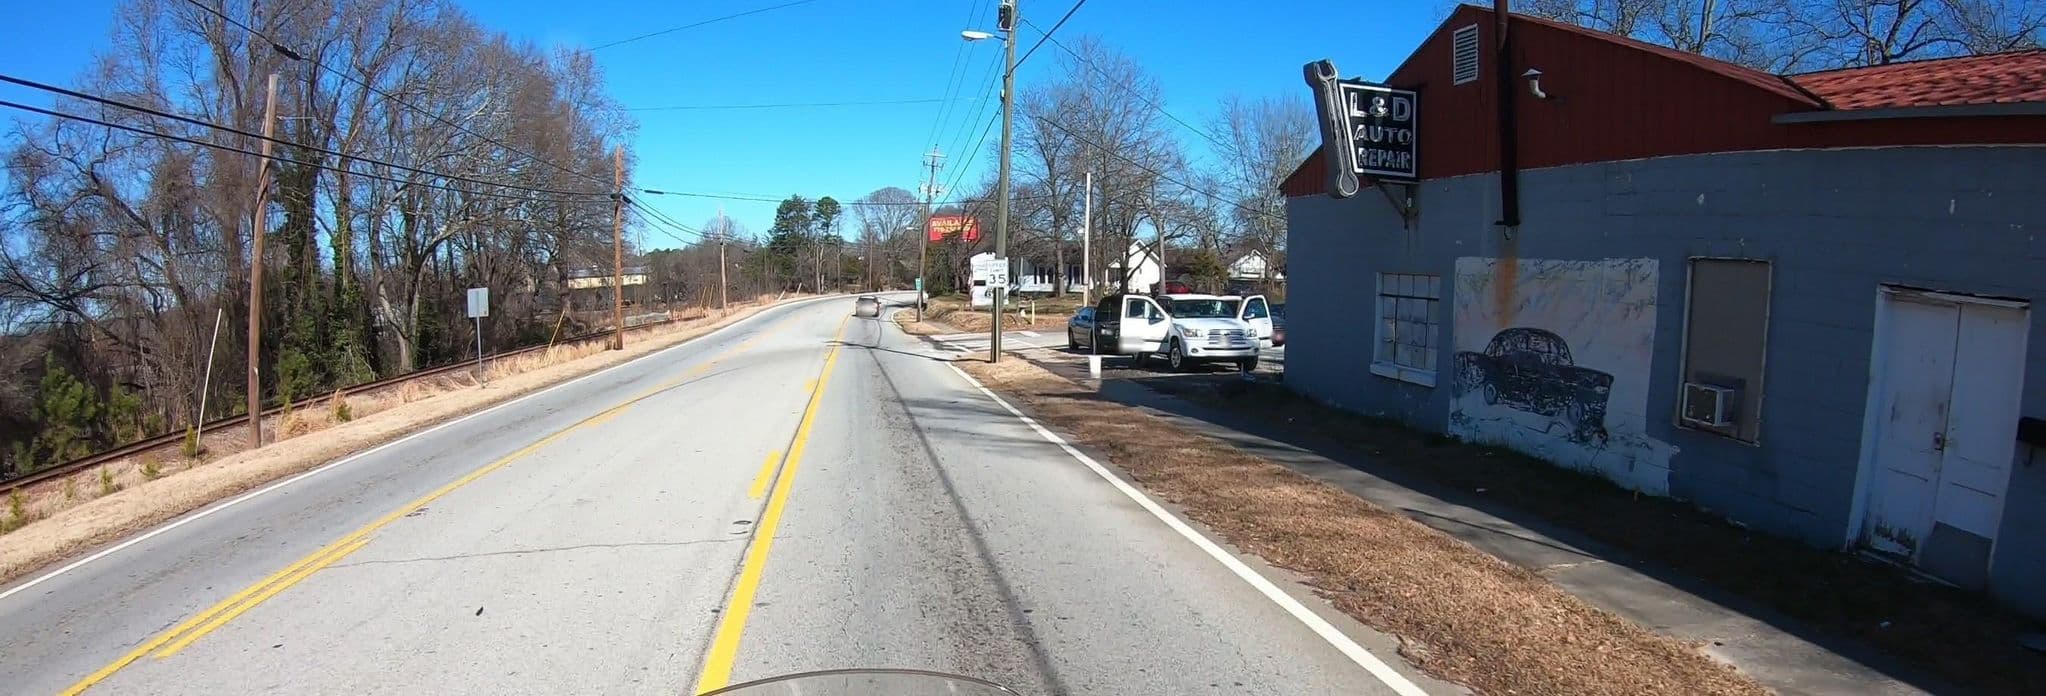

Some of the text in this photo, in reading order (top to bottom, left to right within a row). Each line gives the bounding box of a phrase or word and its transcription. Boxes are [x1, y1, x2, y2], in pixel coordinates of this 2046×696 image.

[1354, 124, 1412, 145] AUTO
[1358, 147, 1411, 169] REPAIR
[932, 219, 974, 227] AVAILALE
[989, 274, 1006, 284] 35
